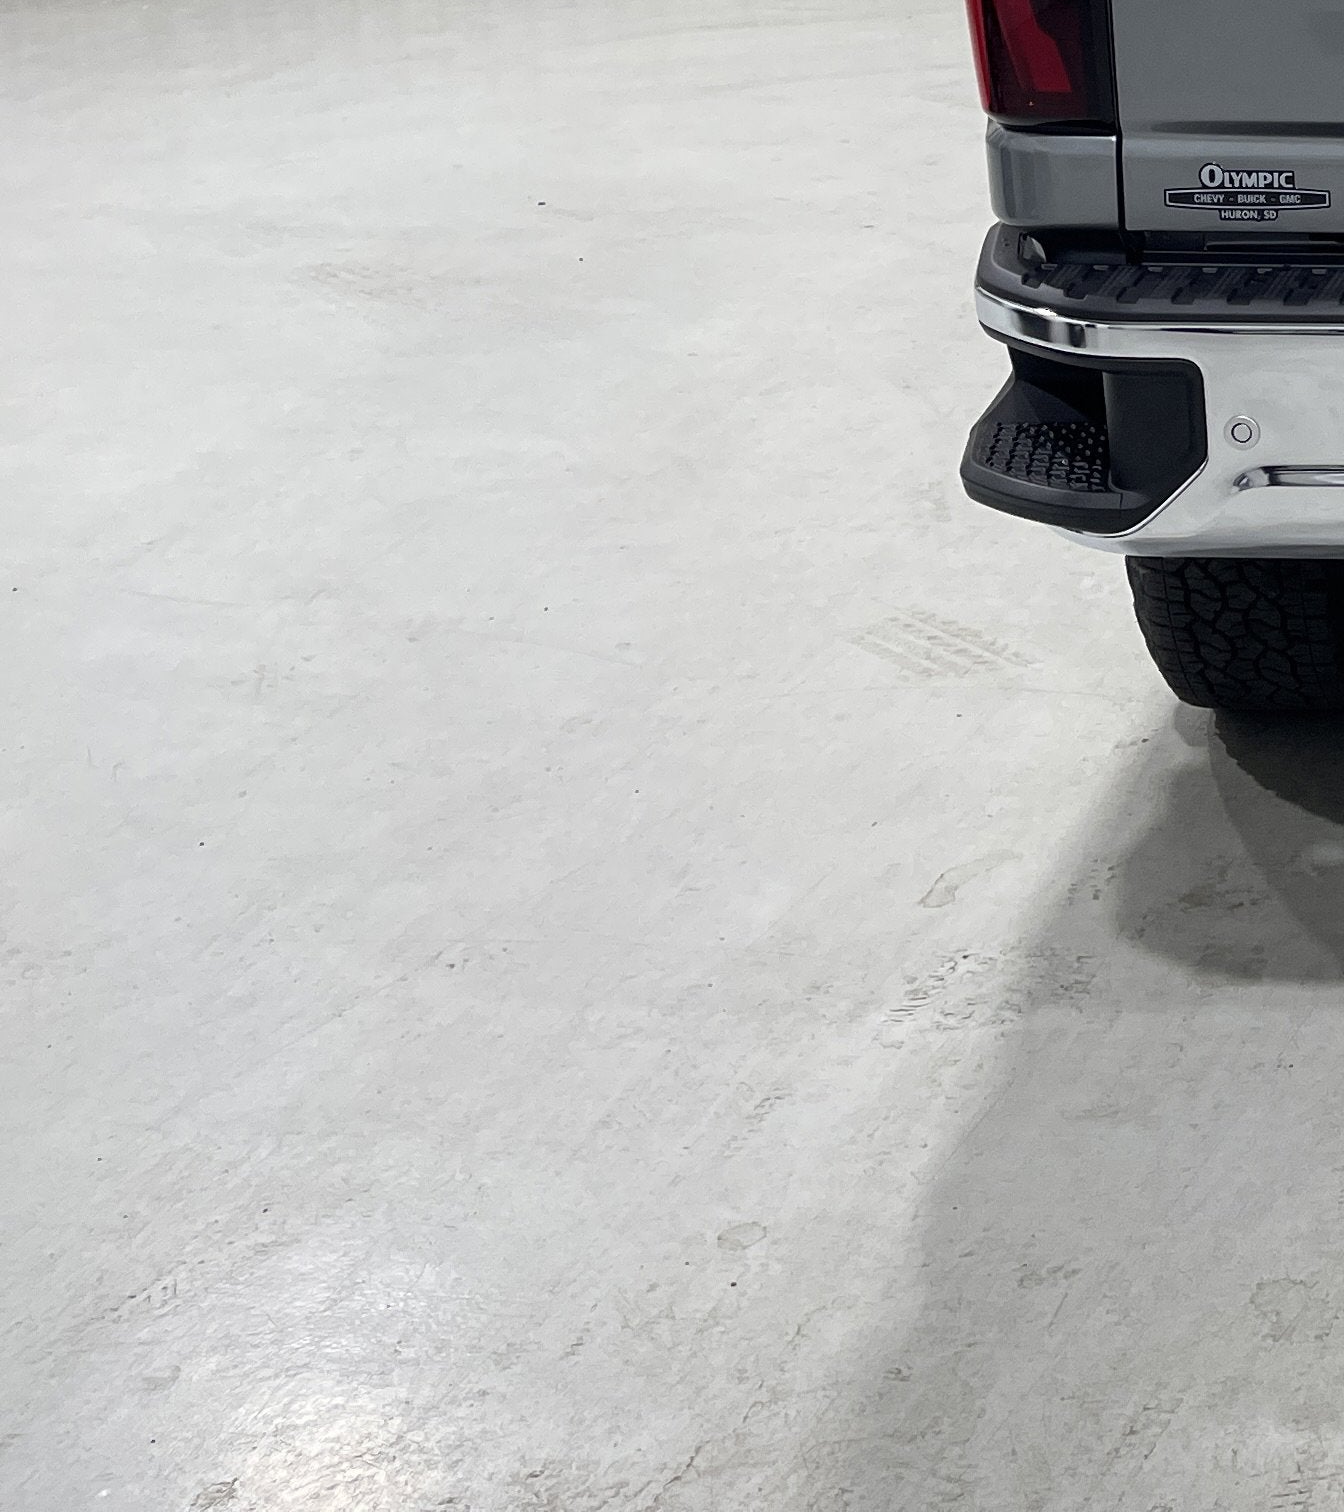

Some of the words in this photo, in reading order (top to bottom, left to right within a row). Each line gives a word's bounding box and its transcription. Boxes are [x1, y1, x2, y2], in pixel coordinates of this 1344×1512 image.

[1194, 193, 1225, 204] CHEVY
[1237, 194, 1266, 204] BUICK
[1279, 194, 1301, 204] GMC
[1221, 210, 1261, 221] HURON,
[1263, 210, 1277, 219] SD
